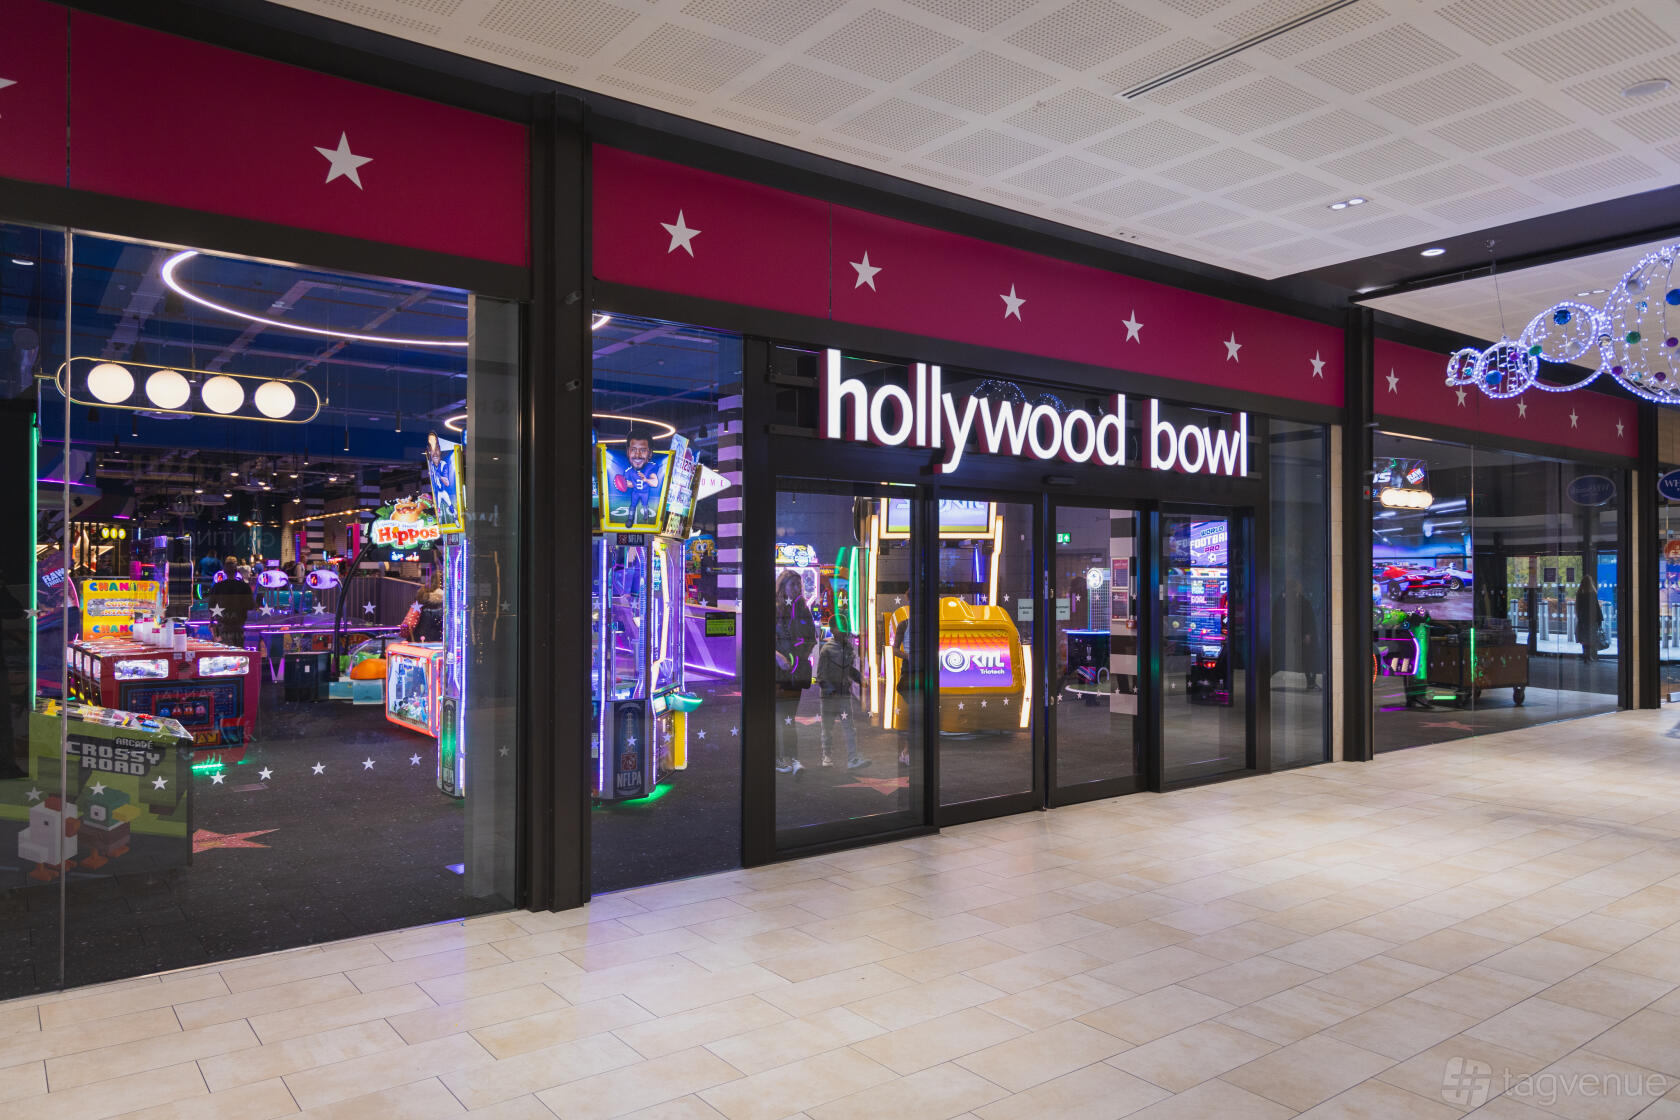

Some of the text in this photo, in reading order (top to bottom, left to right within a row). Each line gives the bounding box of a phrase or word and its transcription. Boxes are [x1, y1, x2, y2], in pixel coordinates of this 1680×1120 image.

[820, 348, 1248, 477] hollywood bowl
[102, 527, 126, 539] VIP
[377, 525, 438, 546] Hippos
[1200, 525, 1225, 537] WORLD
[1203, 544, 1221, 553] PRO
[116, 737, 153, 750] ARCADE
[67, 741, 161, 765] CROSSY
[82, 757, 145, 775] ROAD
[616, 770, 642, 789] NFLPA
